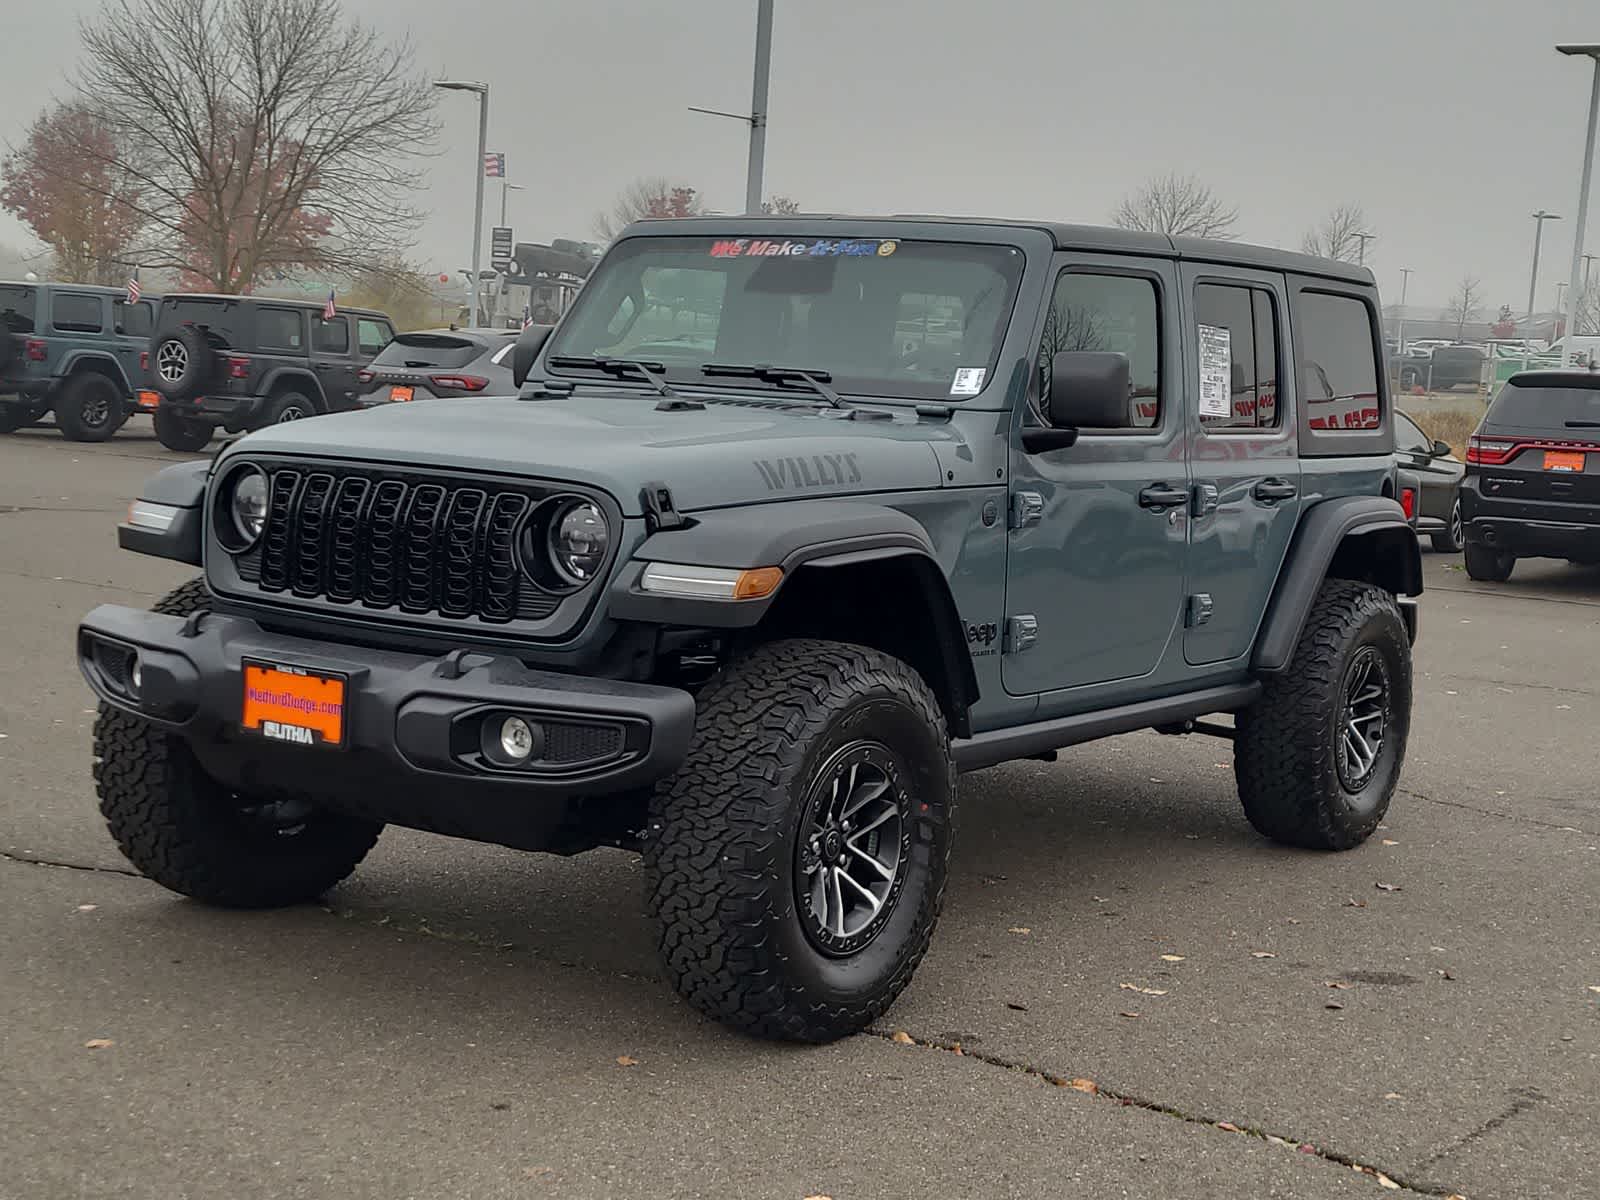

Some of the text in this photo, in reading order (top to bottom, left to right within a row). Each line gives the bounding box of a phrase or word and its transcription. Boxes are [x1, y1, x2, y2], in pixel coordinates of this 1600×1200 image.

[745, 240, 804, 256] Make
[752, 454, 861, 489] WILLYS
[961, 619, 998, 646] Jeep
